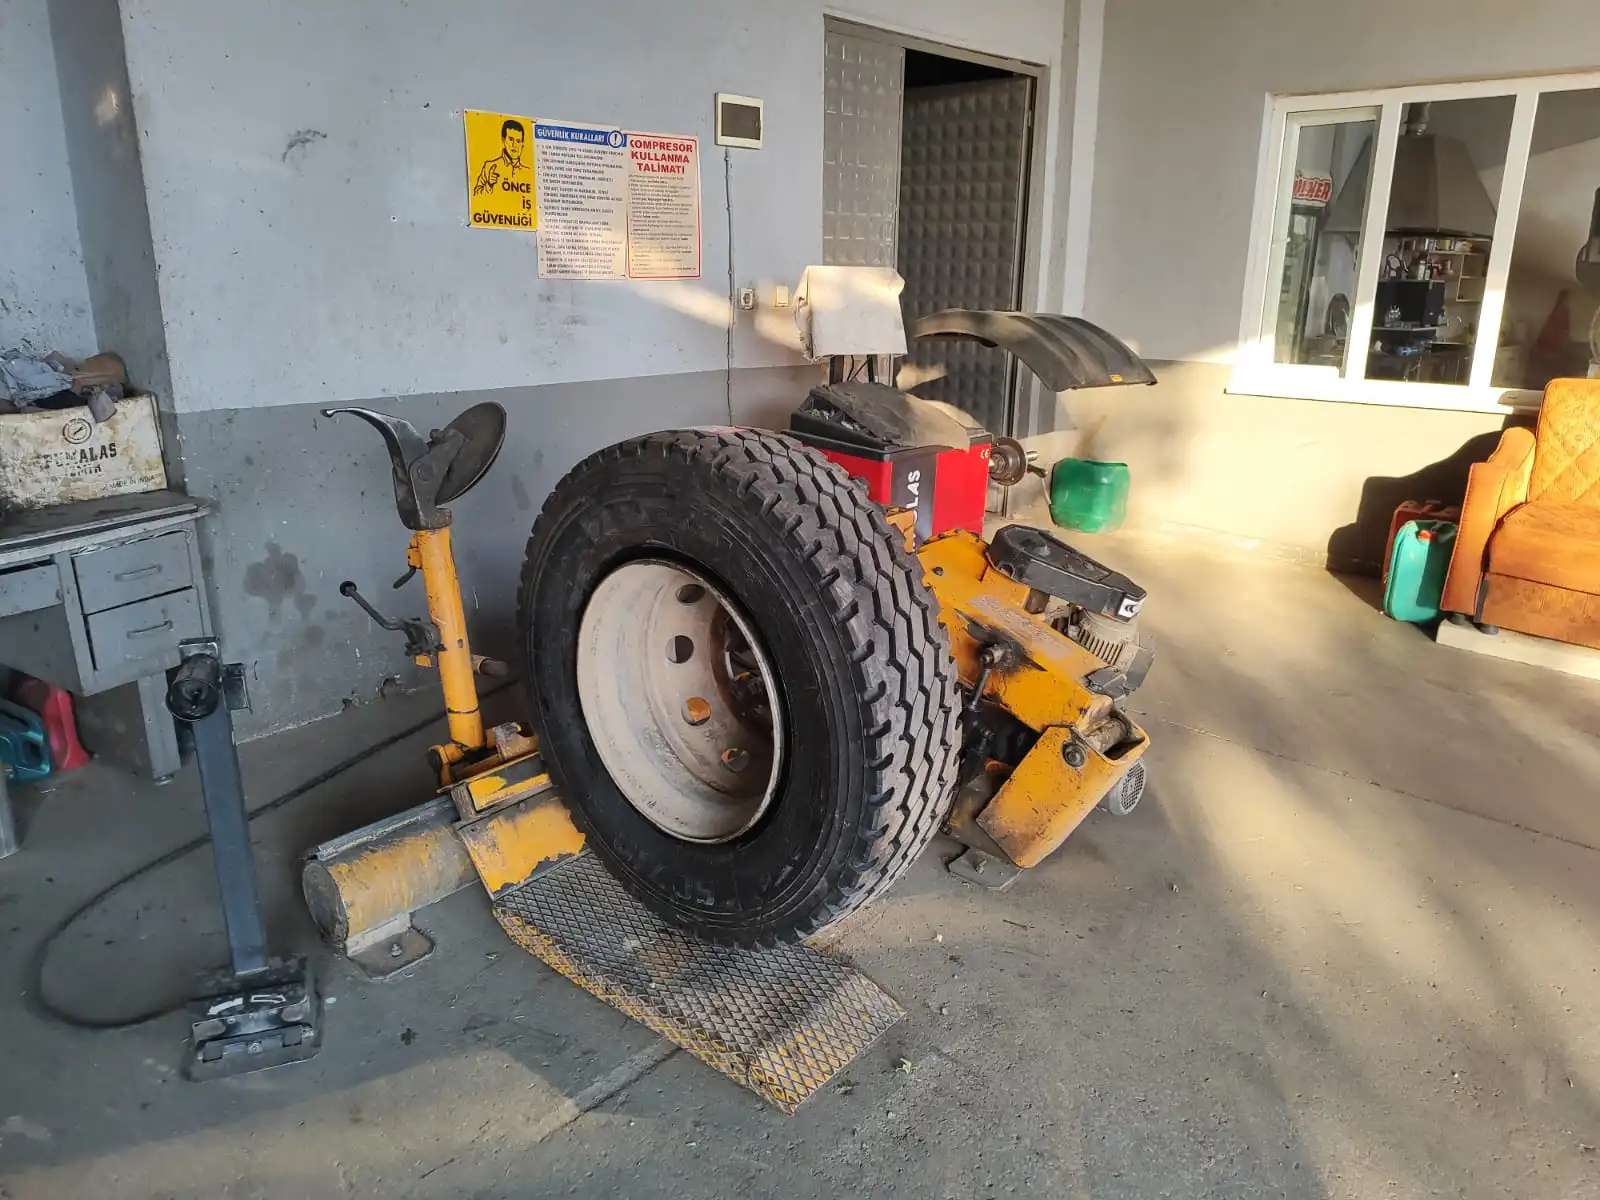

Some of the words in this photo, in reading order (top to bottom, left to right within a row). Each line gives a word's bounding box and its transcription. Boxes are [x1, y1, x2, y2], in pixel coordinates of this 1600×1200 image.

[537, 128, 570, 139] GÜVENLİK
[570, 132, 605, 143] KURALLARI
[631, 151, 690, 163] KULLANMA
[637, 162, 685, 175] TALİMATI
[501, 178, 531, 194] ÖNCE
[522, 196, 532, 209] İŞ
[473, 210, 532, 226] GÜVENLİĞİ
